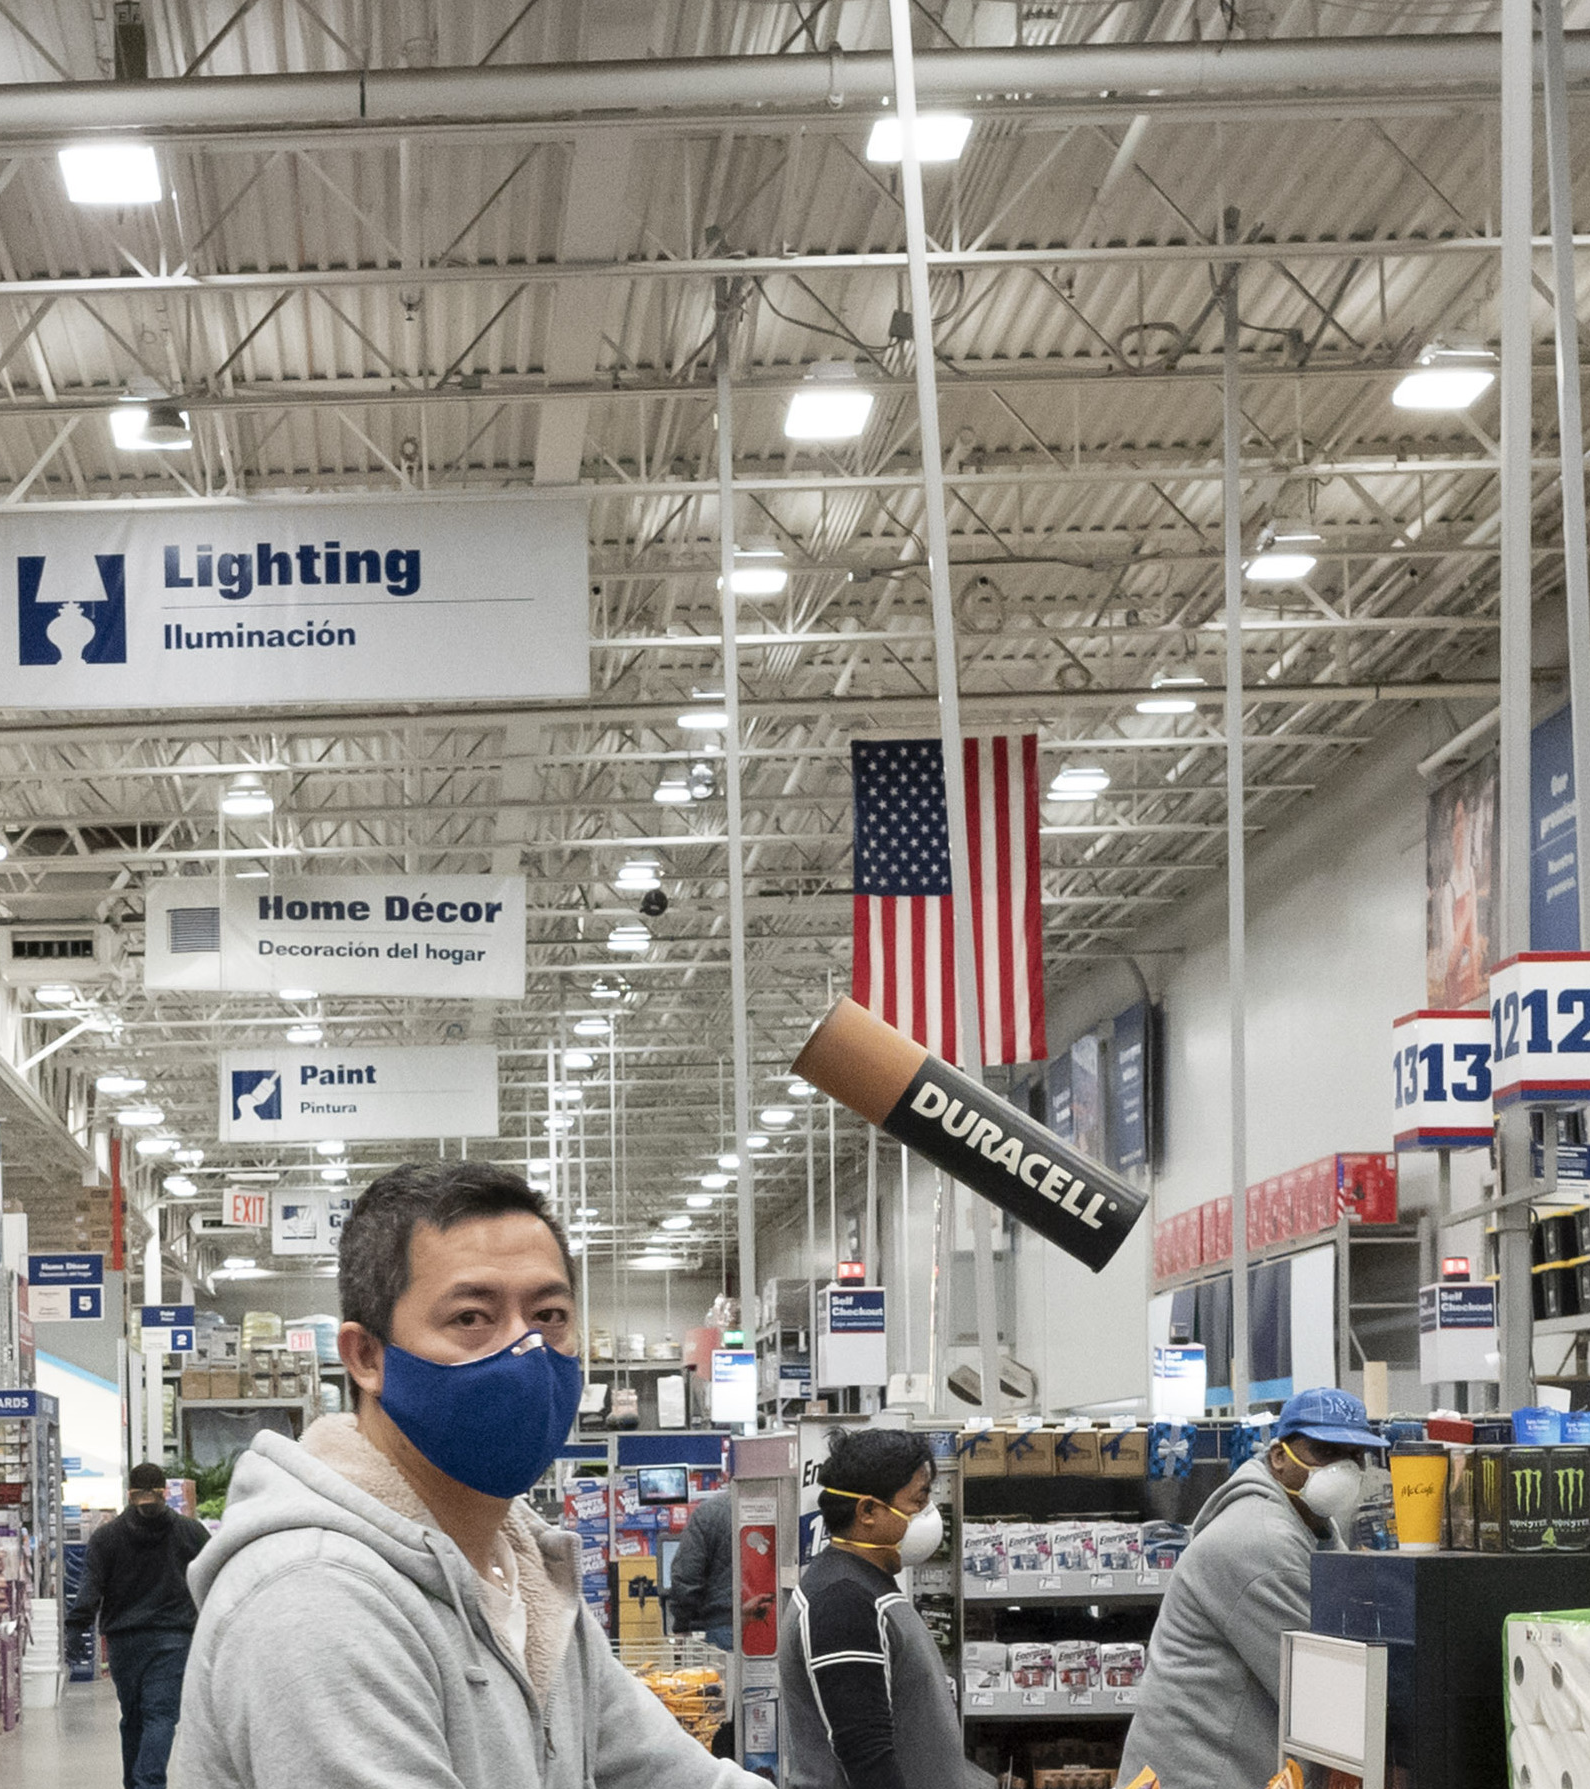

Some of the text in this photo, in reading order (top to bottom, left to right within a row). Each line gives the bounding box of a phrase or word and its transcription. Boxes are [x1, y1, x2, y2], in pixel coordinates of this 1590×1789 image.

[163, 540, 422, 600] Lighting
[163, 619, 357, 650] Iluminación
[258, 892, 503, 923] Home Décor
[258, 940, 487, 966] Decoración del hogar
[1490, 990, 1520, 1063] 12
[300, 1064, 377, 1086] Paint
[1393, 1044, 1419, 1110] 13
[1418, 1043, 1492, 1102] 13
[300, 1101, 358, 1115] Pintura
[910, 1080, 1106, 1230] DURACELL
[233, 1195, 266, 1224] EXIT
[77, 1296, 92, 1311] 5
[832, 1296, 854, 1306] Self
[1440, 1291, 1463, 1301] Self
[832, 1306, 884, 1316] Checkout
[1440, 1303, 1493, 1312] Checkout
[176, 1335, 188, 1346] 2
[964, 1533, 1003, 1549] Energizer
[1009, 1532, 1048, 1547] Energizer
[1054, 1529, 1094, 1544] Energizer
[1099, 1529, 1139, 1546] Energizer
[1015, 1648, 1051, 1662] Energizer
[1059, 1647, 1098, 1662] Energizer
[1103, 1649, 1142, 1663] Energizer
